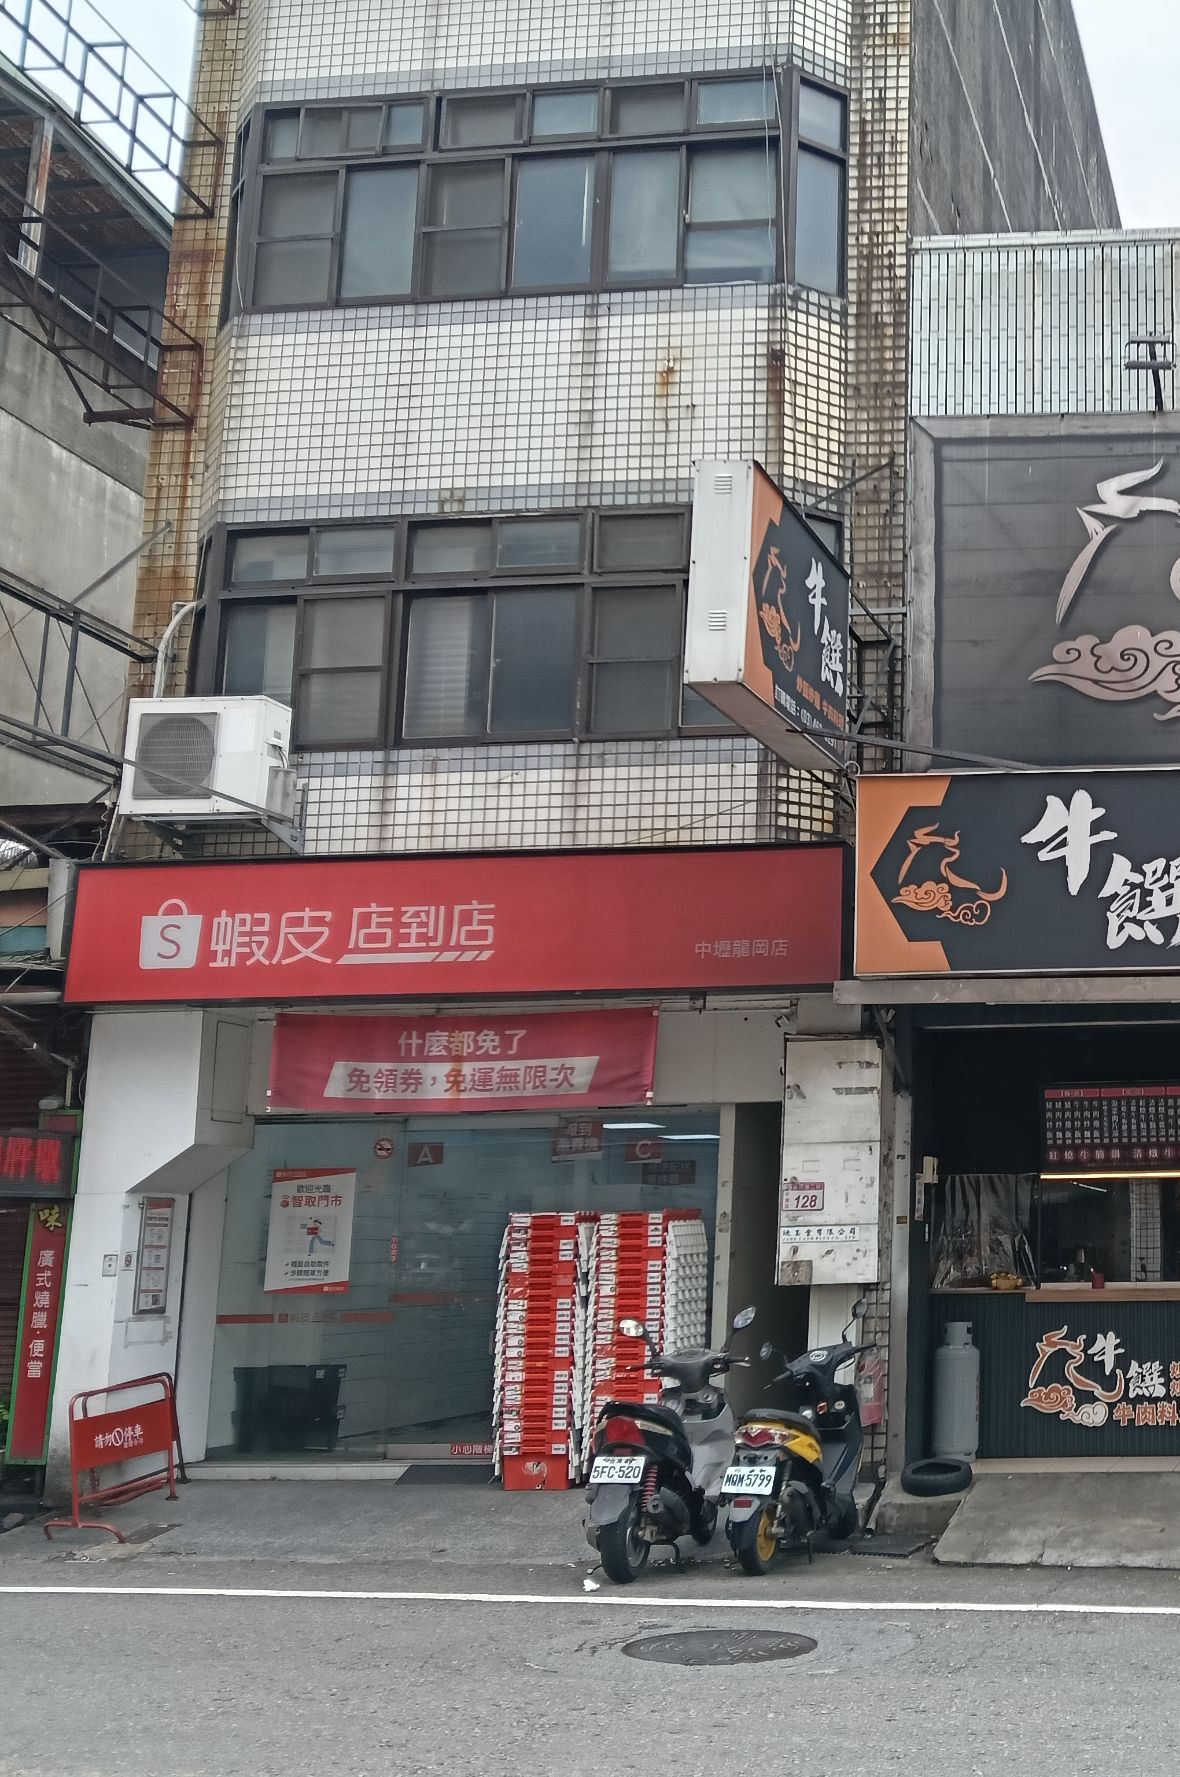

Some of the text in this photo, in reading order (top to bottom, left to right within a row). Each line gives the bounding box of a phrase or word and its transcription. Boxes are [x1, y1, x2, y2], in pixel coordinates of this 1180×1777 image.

[209, 907, 332, 967] 蝦皮
[347, 900, 495, 949] 店到店
[695, 939, 789, 959] 中壢龍岡店
[398, 1029, 527, 1057] 什麼都免了
[346, 1064, 575, 1094] 免領券，免運無限次
[635, 1140, 652, 1158] C
[291, 1194, 343, 1207] 智取門市
[795, 1195, 817, 1208] 128
[592, 1465, 641, 1479] 5FC-520
